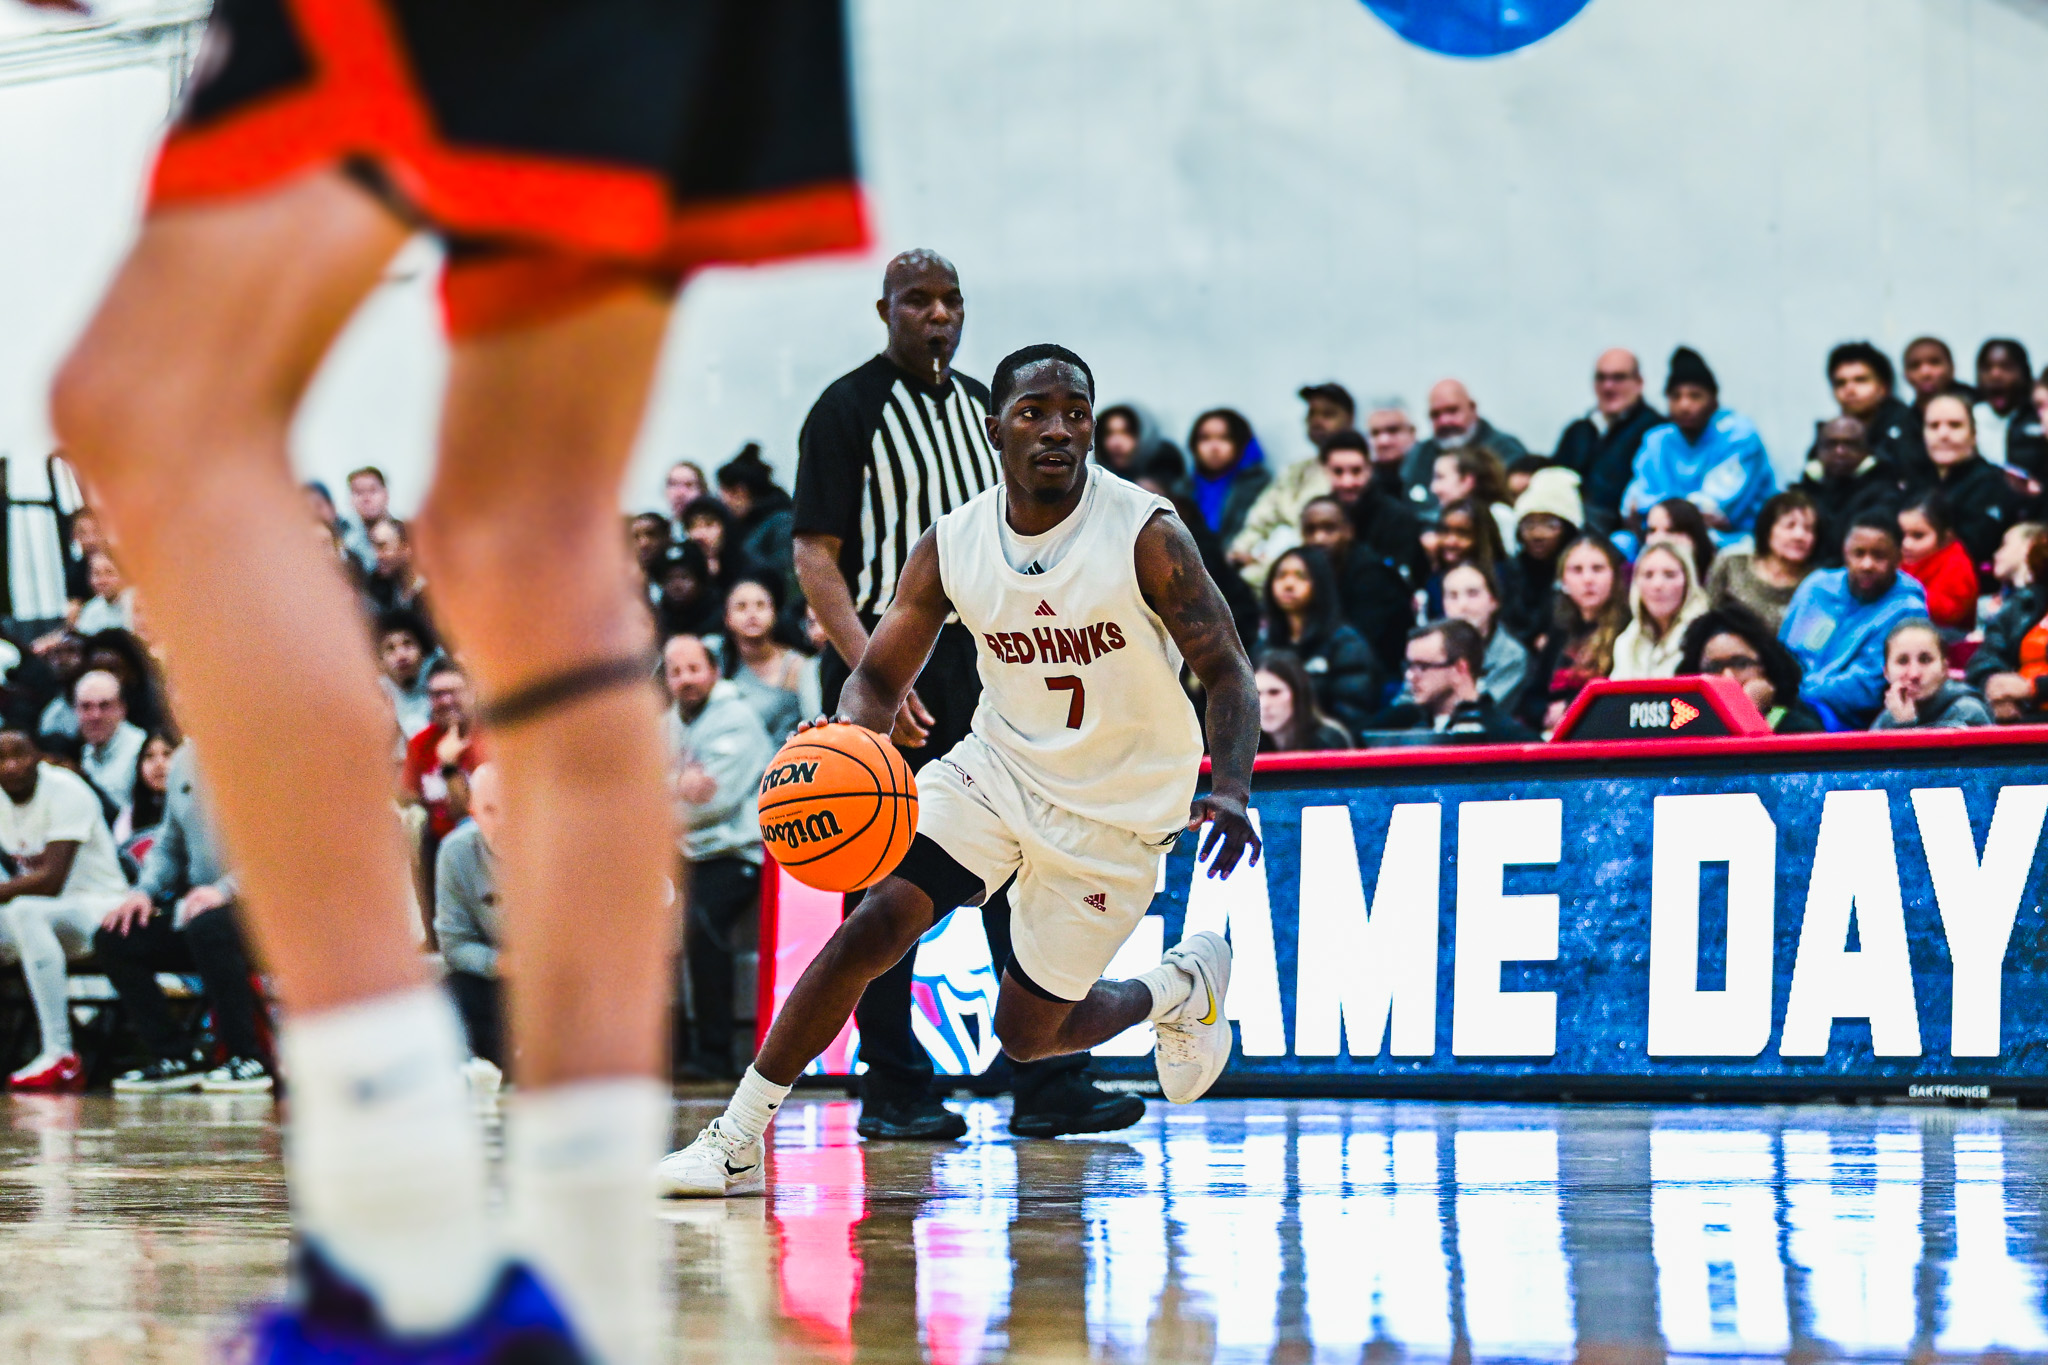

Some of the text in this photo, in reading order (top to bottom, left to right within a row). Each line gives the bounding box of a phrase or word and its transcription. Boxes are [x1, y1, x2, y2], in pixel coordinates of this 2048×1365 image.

[982, 621, 1127, 666] RED HAWKS
[1044, 675, 1085, 730] 7
[1629, 701, 1671, 728] POSS
[761, 761, 819, 795] NCAA
[760, 809, 843, 849] Wilson
[1083, 895, 1107, 912] adidas
[1647, 787, 2048, 1057] DAY
[1908, 1083, 1990, 1099] DAKTRONICS
